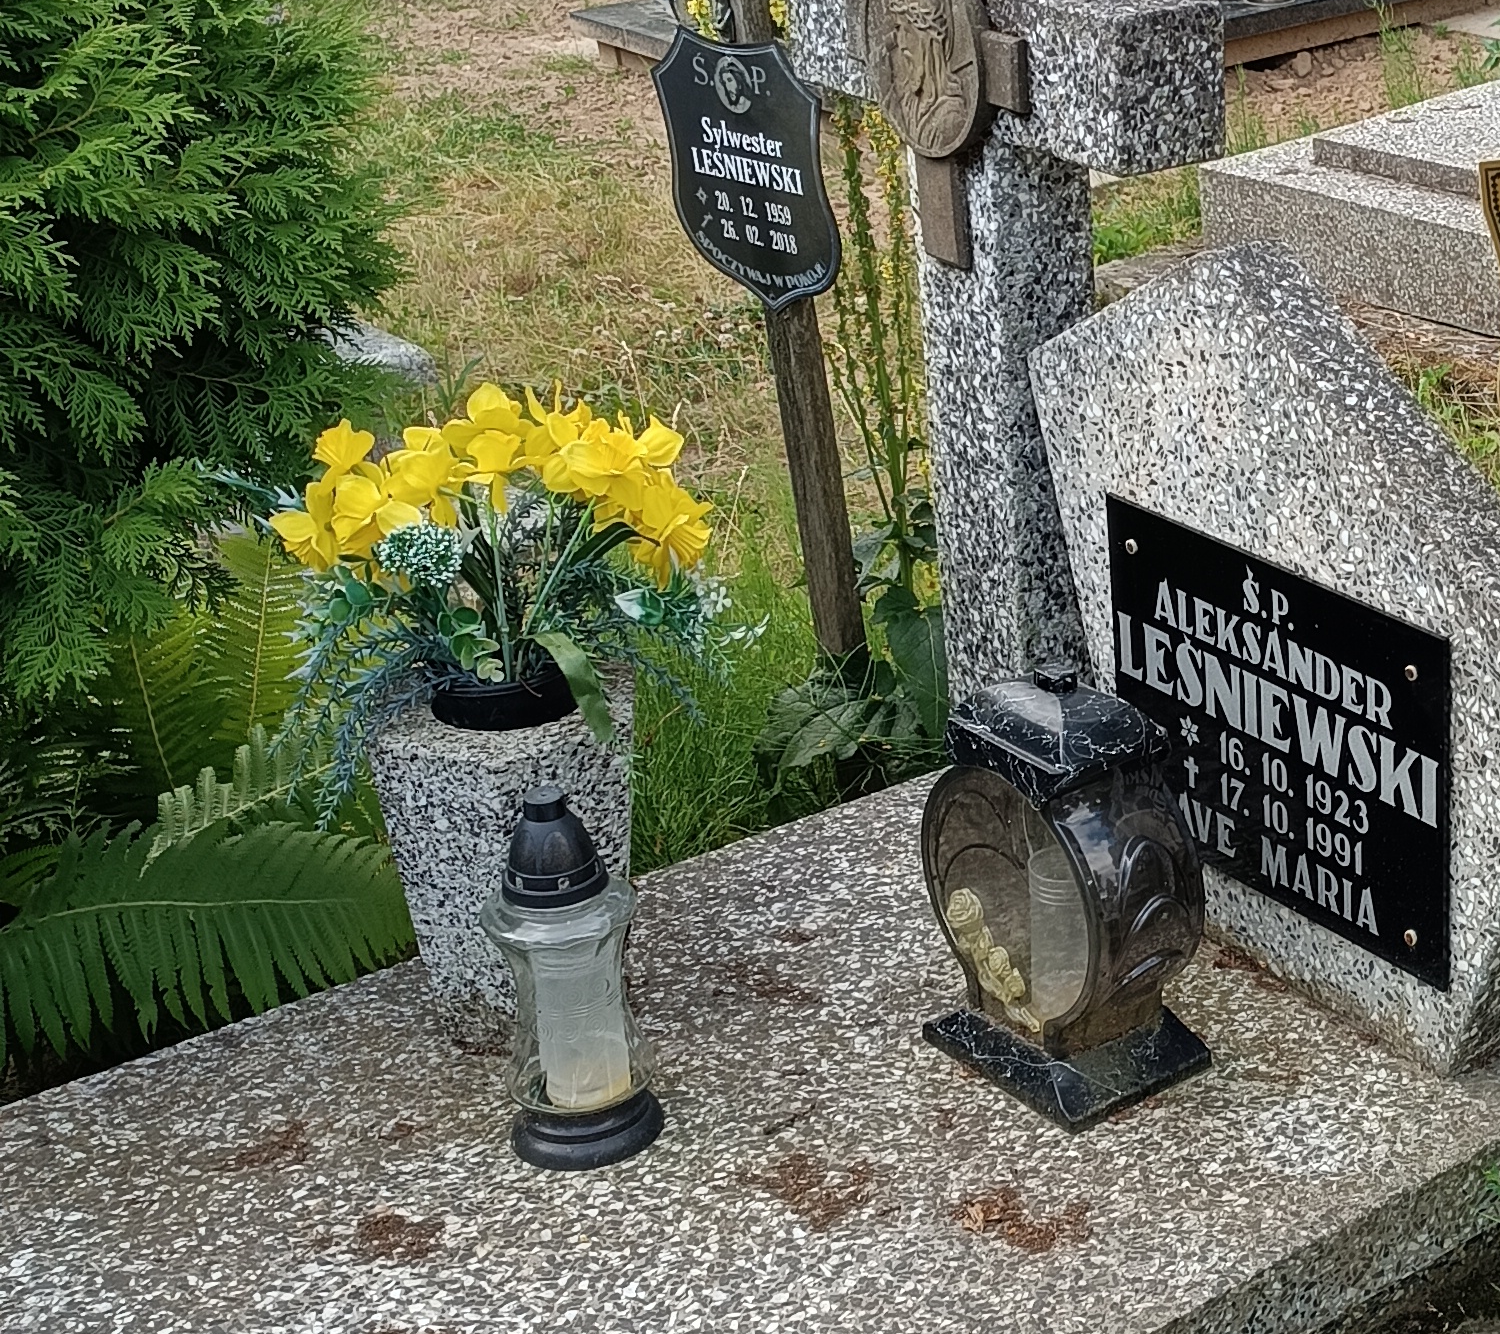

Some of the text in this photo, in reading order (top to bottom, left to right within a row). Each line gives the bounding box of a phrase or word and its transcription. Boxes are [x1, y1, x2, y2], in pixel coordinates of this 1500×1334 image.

[700, 116, 782, 159] Sylwester
[691, 146, 803, 196] LEŚNIEWSKI
[714, 190, 792, 226] 20. 12. 1959
[720, 219, 798, 255] 26. 02. 2018
[772, 275, 783, 288] W
[1243, 565, 1295, 631] Ś.P.
[1154, 577, 1392, 730] ALEKSANDER
[1117, 610, 1439, 829] LEŚNIEWSKI
[1219, 731, 1369, 835] 16. 10. 1923
[1220, 772, 1250, 817] 17.
[1262, 794, 1295, 840] 10.
[1306, 817, 1363, 876] 1991
[1260, 836, 1379, 936] MARIA
